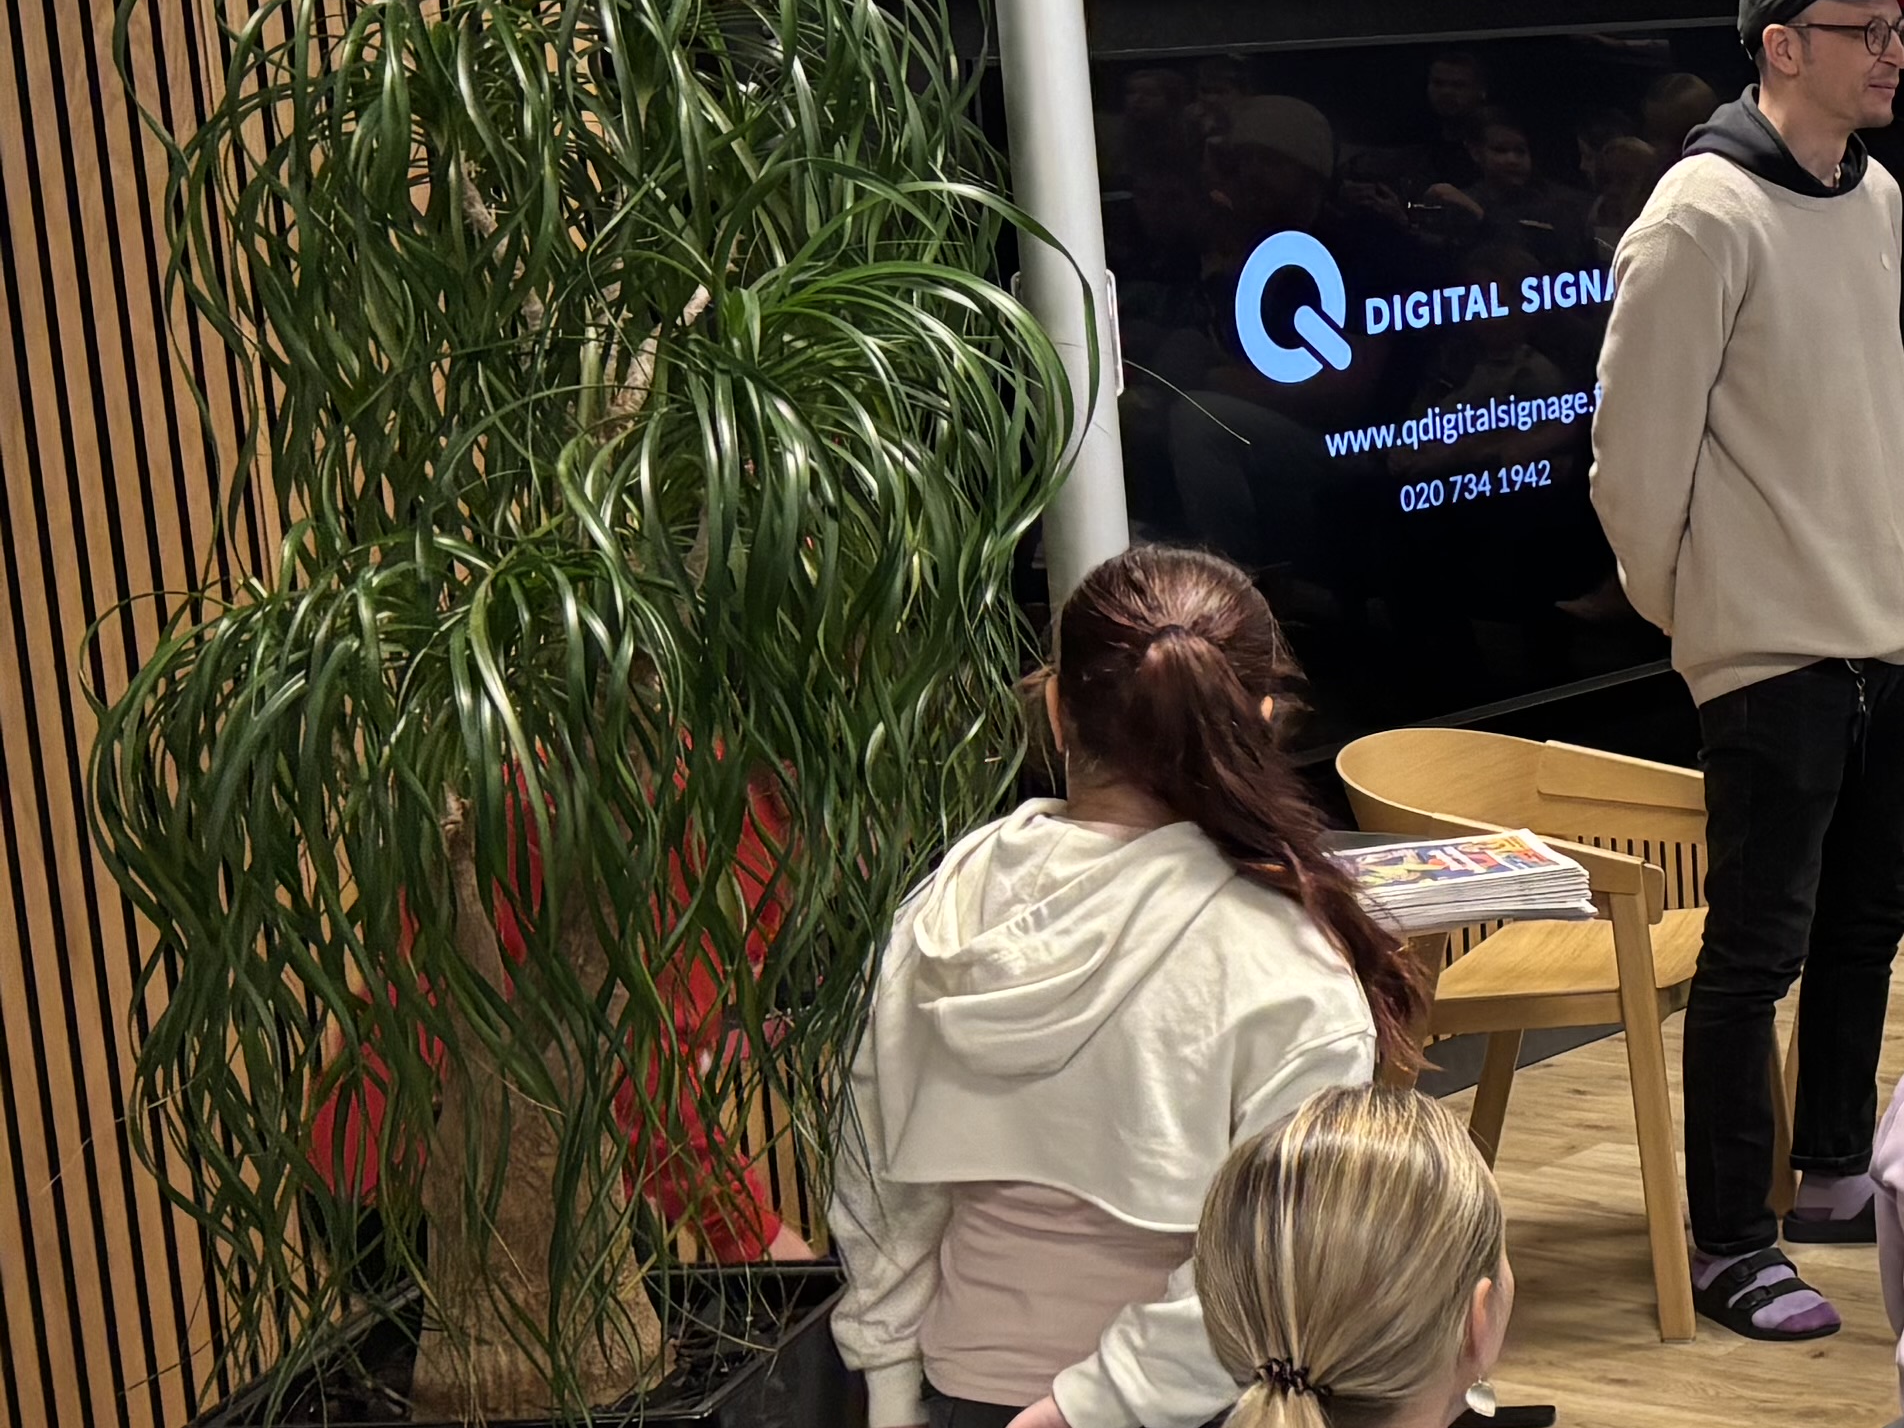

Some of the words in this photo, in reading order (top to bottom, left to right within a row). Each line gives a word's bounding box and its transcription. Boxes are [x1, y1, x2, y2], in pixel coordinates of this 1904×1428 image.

[1366, 282, 1509, 335] DIGITAL
[1400, 479, 1444, 512] 020
[1449, 470, 1491, 503] 734
[1499, 459, 1551, 494] 1942
